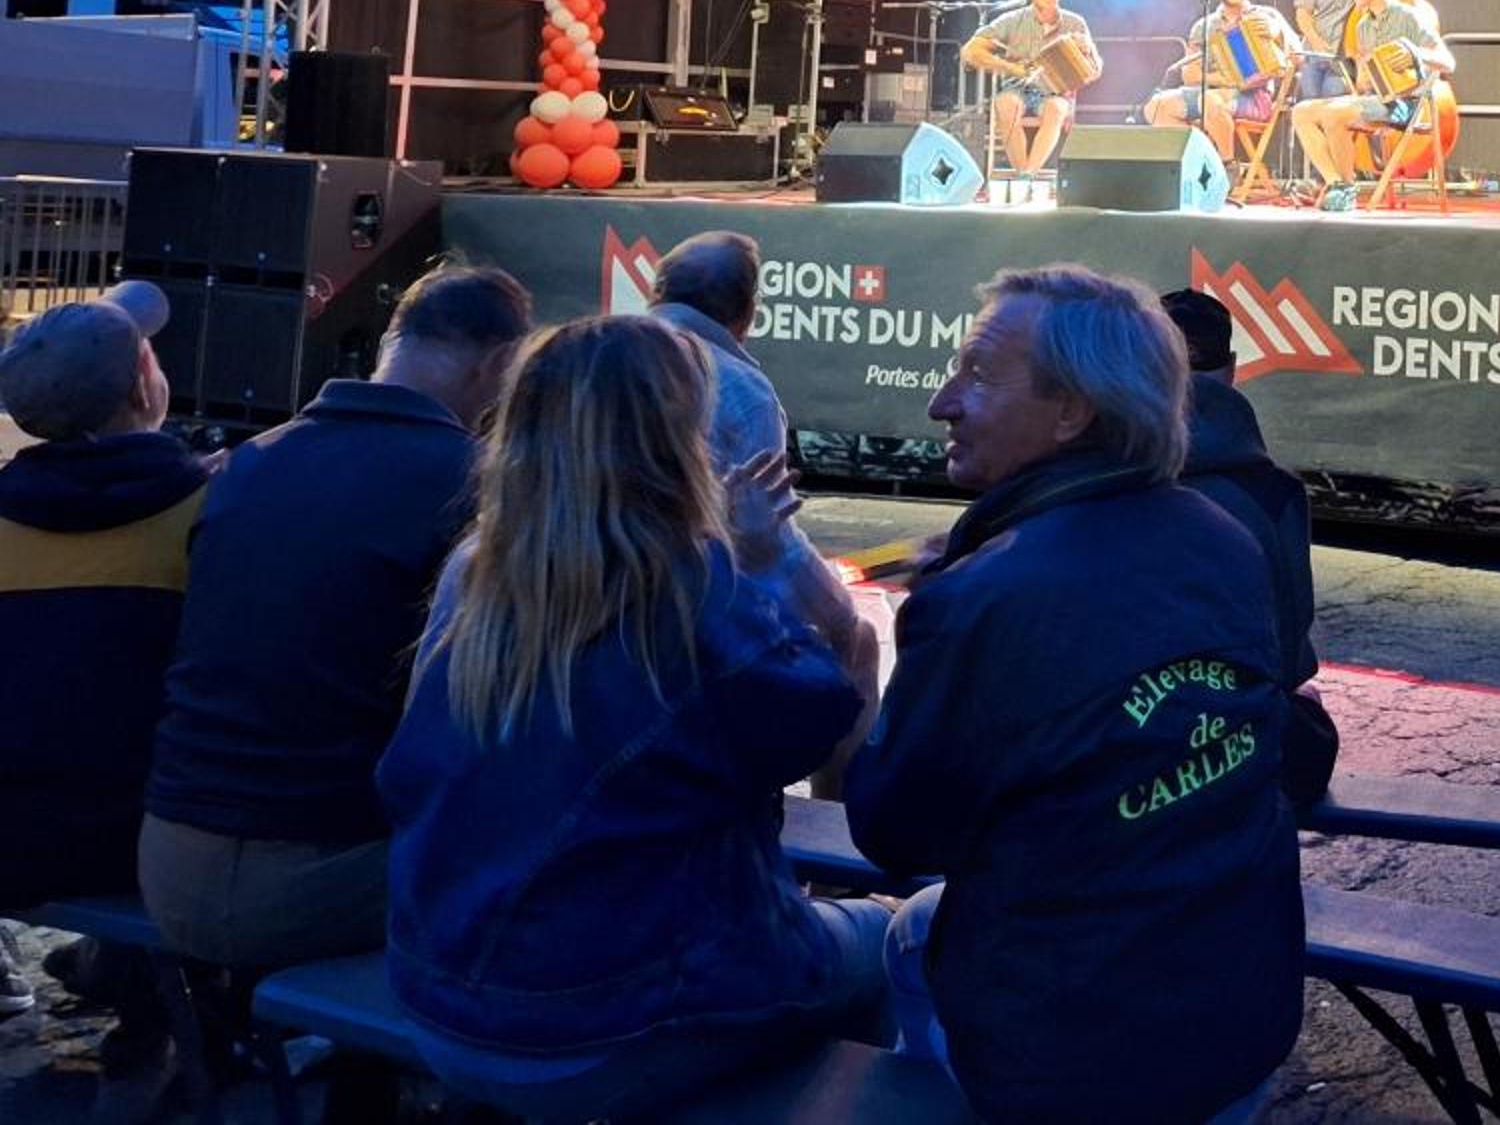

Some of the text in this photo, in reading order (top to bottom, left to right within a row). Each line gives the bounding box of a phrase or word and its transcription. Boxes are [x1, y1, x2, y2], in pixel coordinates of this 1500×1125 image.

[758, 260, 852, 300] GION
[868, 308, 922, 347] DU
[1332, 286, 1500, 335] REGION
[865, 364, 919, 389] Portes
[922, 368, 947, 389] du
[1189, 712, 1226, 748] de
[1118, 722, 1257, 820] CARLES
